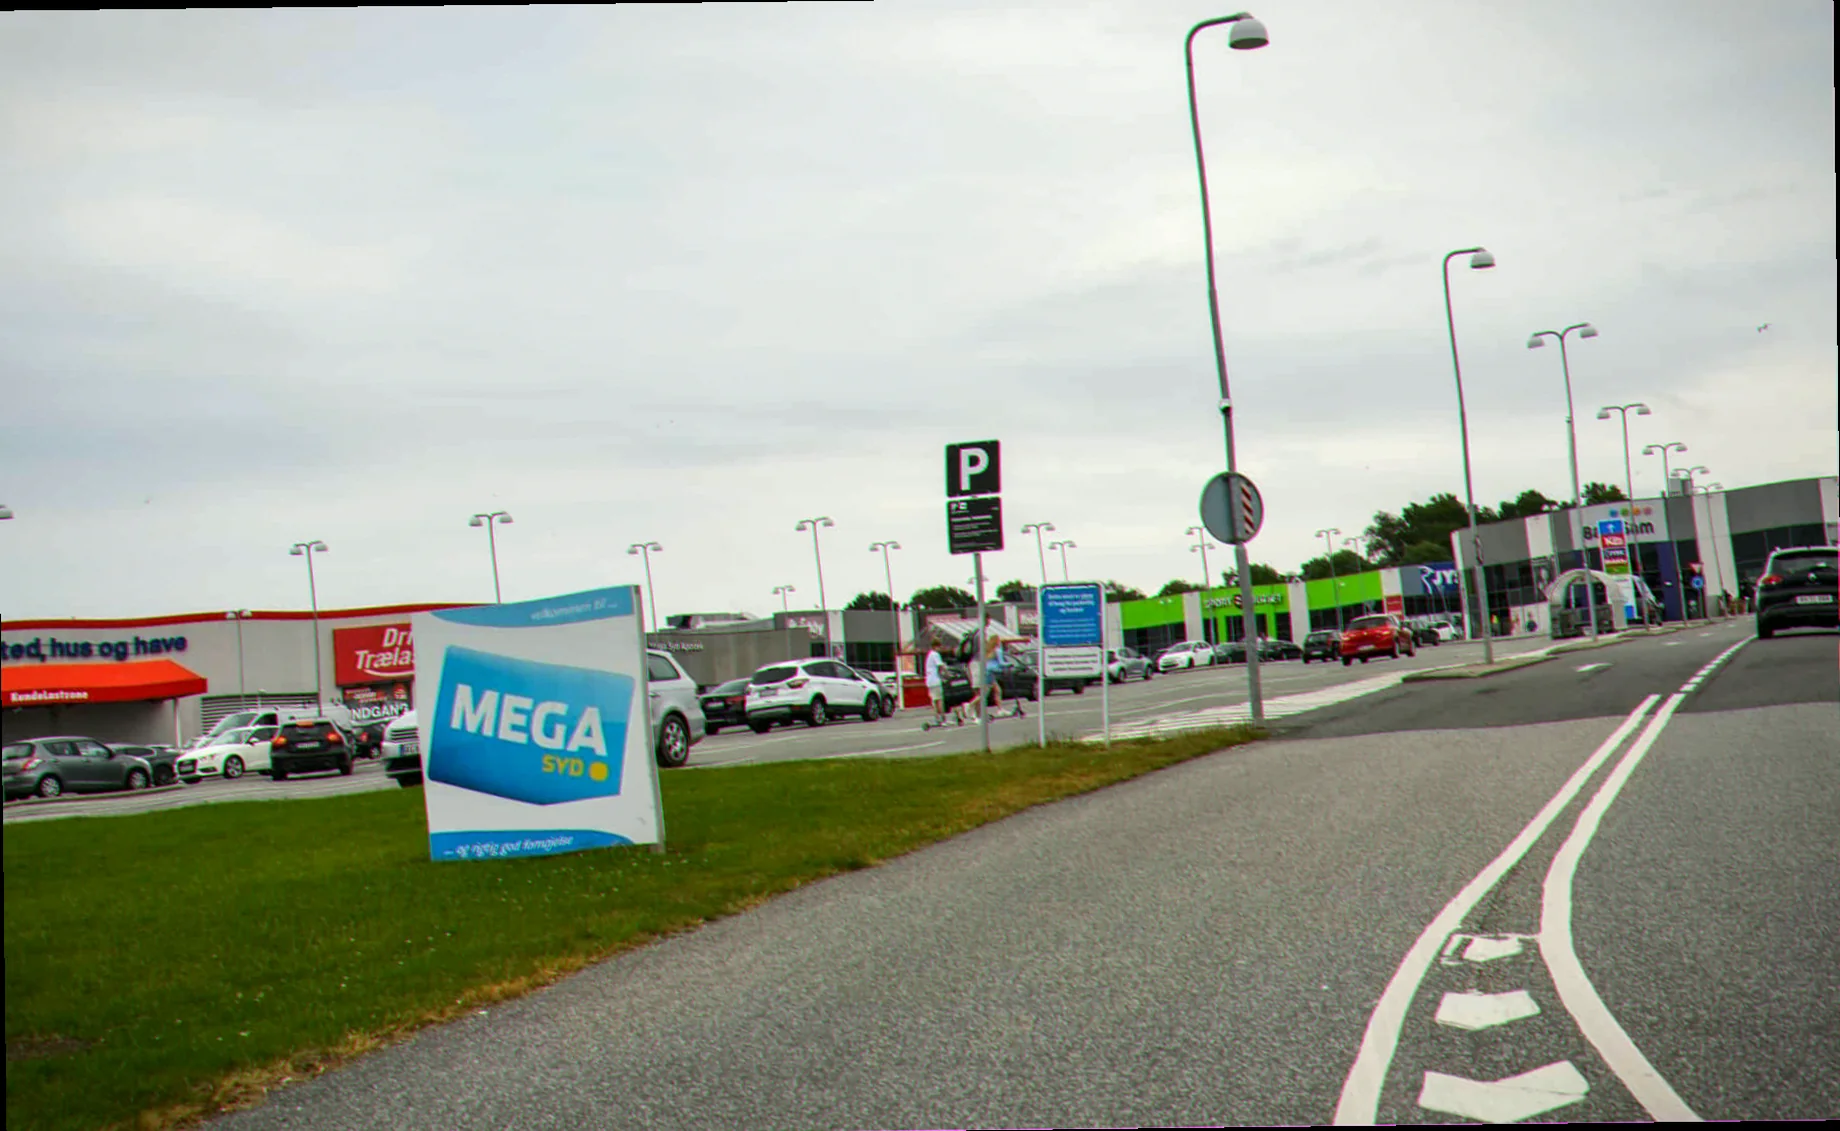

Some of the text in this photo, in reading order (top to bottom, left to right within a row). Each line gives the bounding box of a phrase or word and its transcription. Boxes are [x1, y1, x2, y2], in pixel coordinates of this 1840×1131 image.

[959, 447, 989, 491] P
[50, 637, 93, 657] hus
[99, 641, 128, 661] og
[134, 636, 188, 655] have
[355, 648, 414, 670] Træla
[450, 683, 609, 757] MEGA
[542, 754, 585, 777] SYD
[499, 840, 523, 857] god
